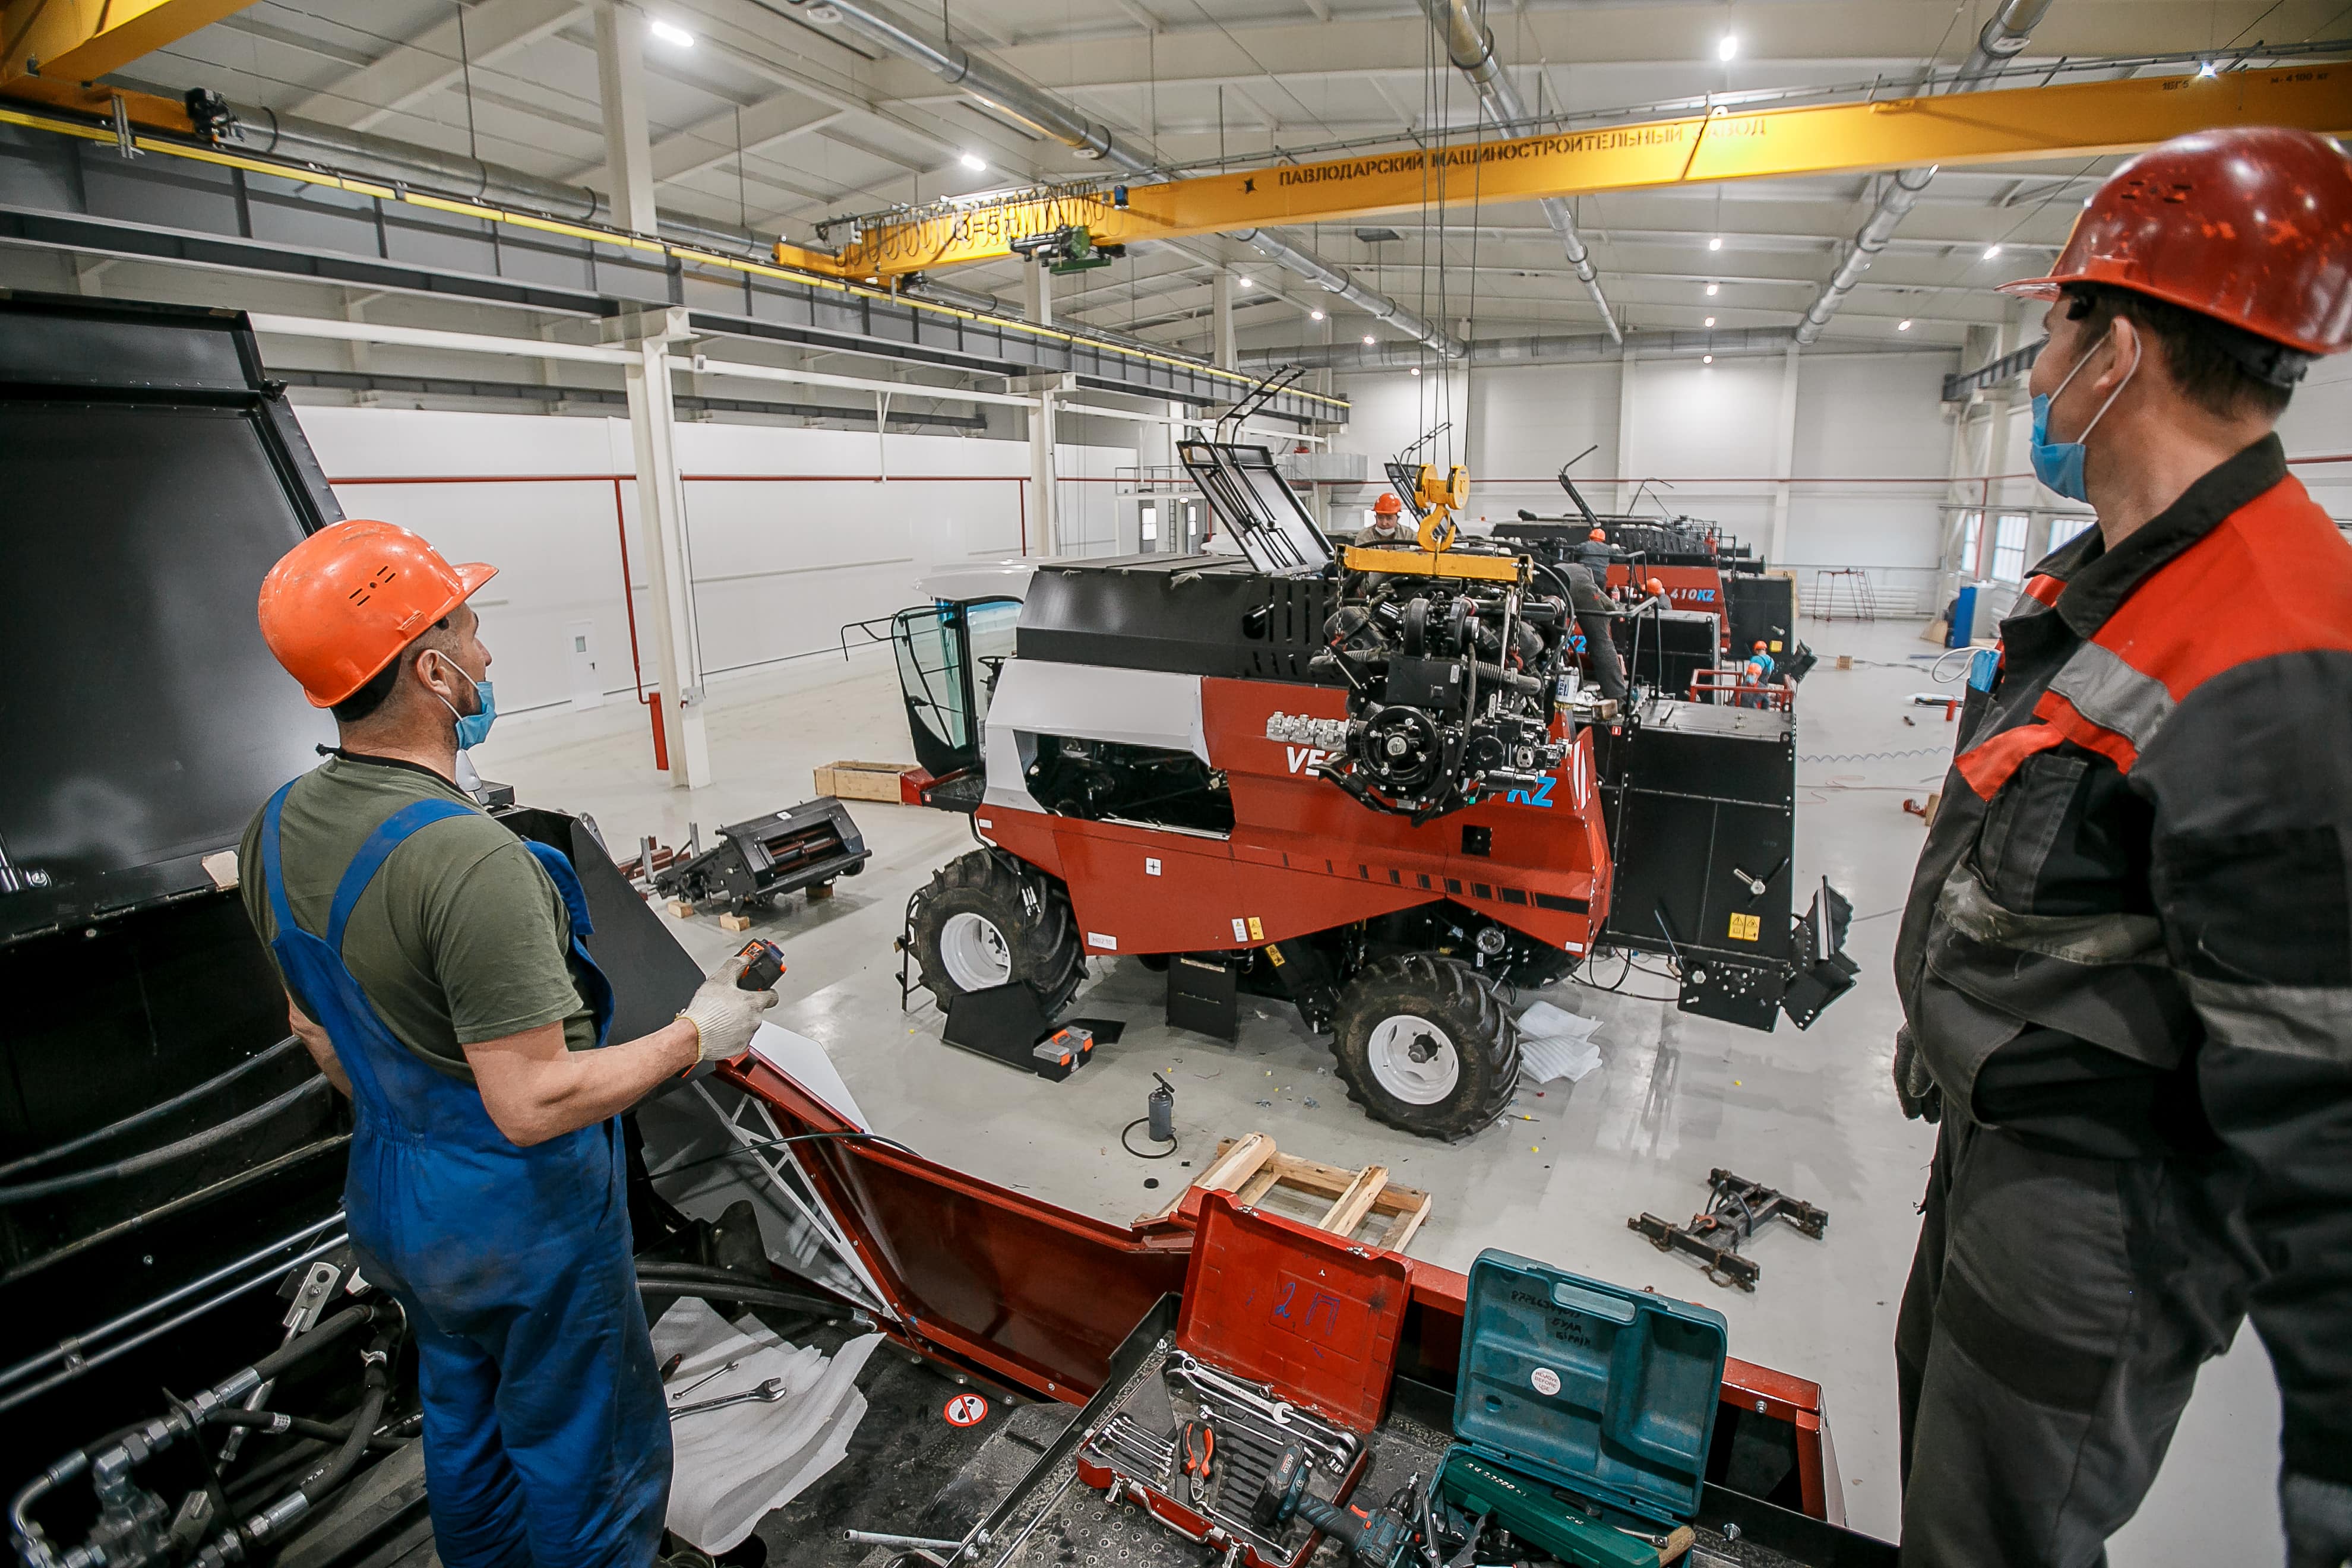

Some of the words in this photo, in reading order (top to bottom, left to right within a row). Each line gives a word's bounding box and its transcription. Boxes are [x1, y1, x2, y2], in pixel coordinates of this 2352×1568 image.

[1279, 152, 1424, 186] ПАВЛОДАРСКИЙ
[1534, 1376, 1556, 1389] BEFORE
[1535, 1371, 1558, 1384] REMOVE
[1539, 1383, 1550, 1392] USE
